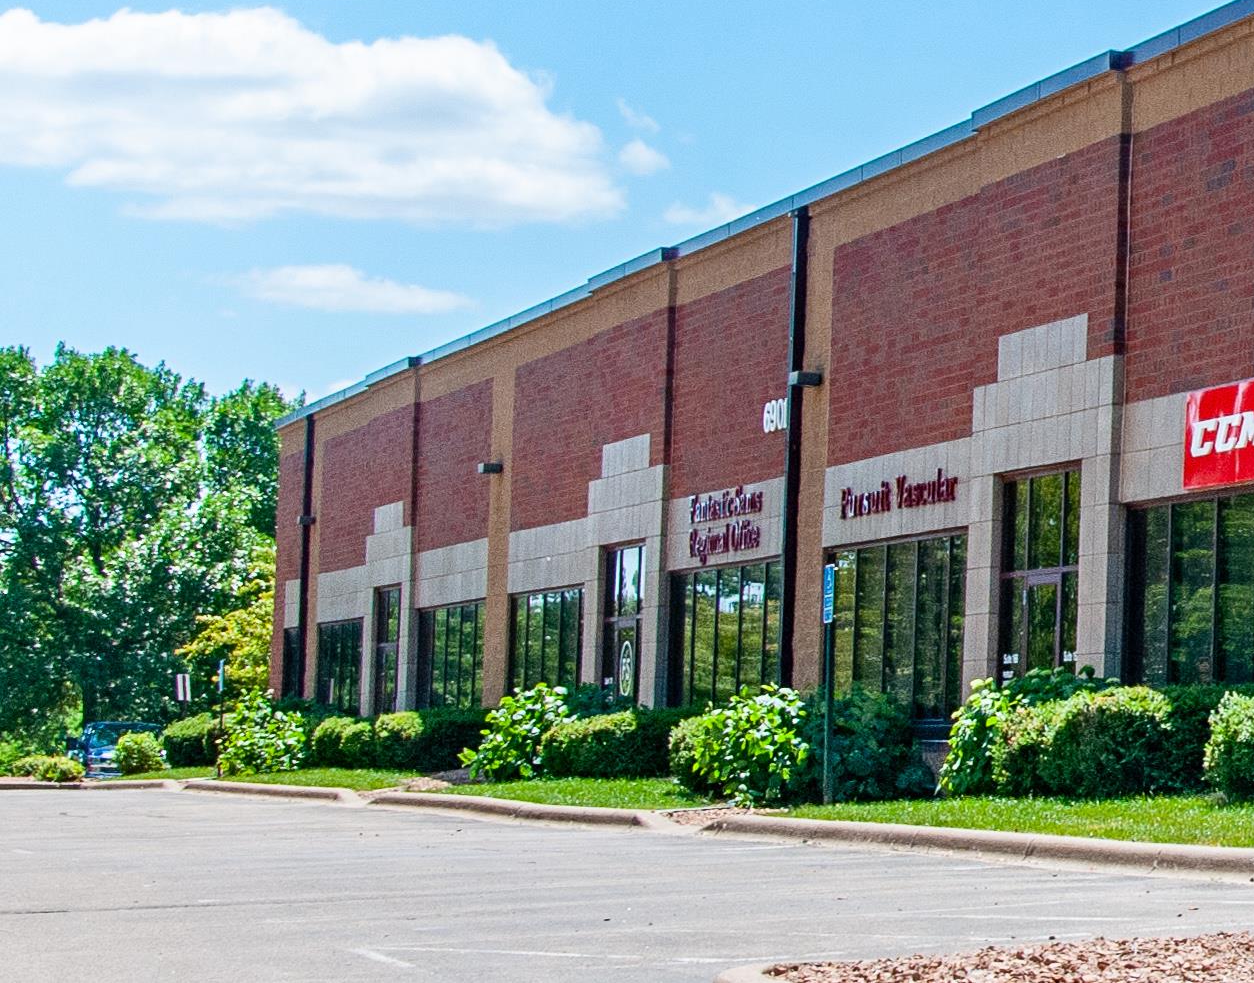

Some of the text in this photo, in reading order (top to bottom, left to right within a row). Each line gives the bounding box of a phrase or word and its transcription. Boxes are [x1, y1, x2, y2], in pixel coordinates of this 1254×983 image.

[690, 485, 763, 524] Fantastic Sams
[841, 468, 958, 520] Pursuit Vascular
[690, 520, 760, 565] Regional Office
